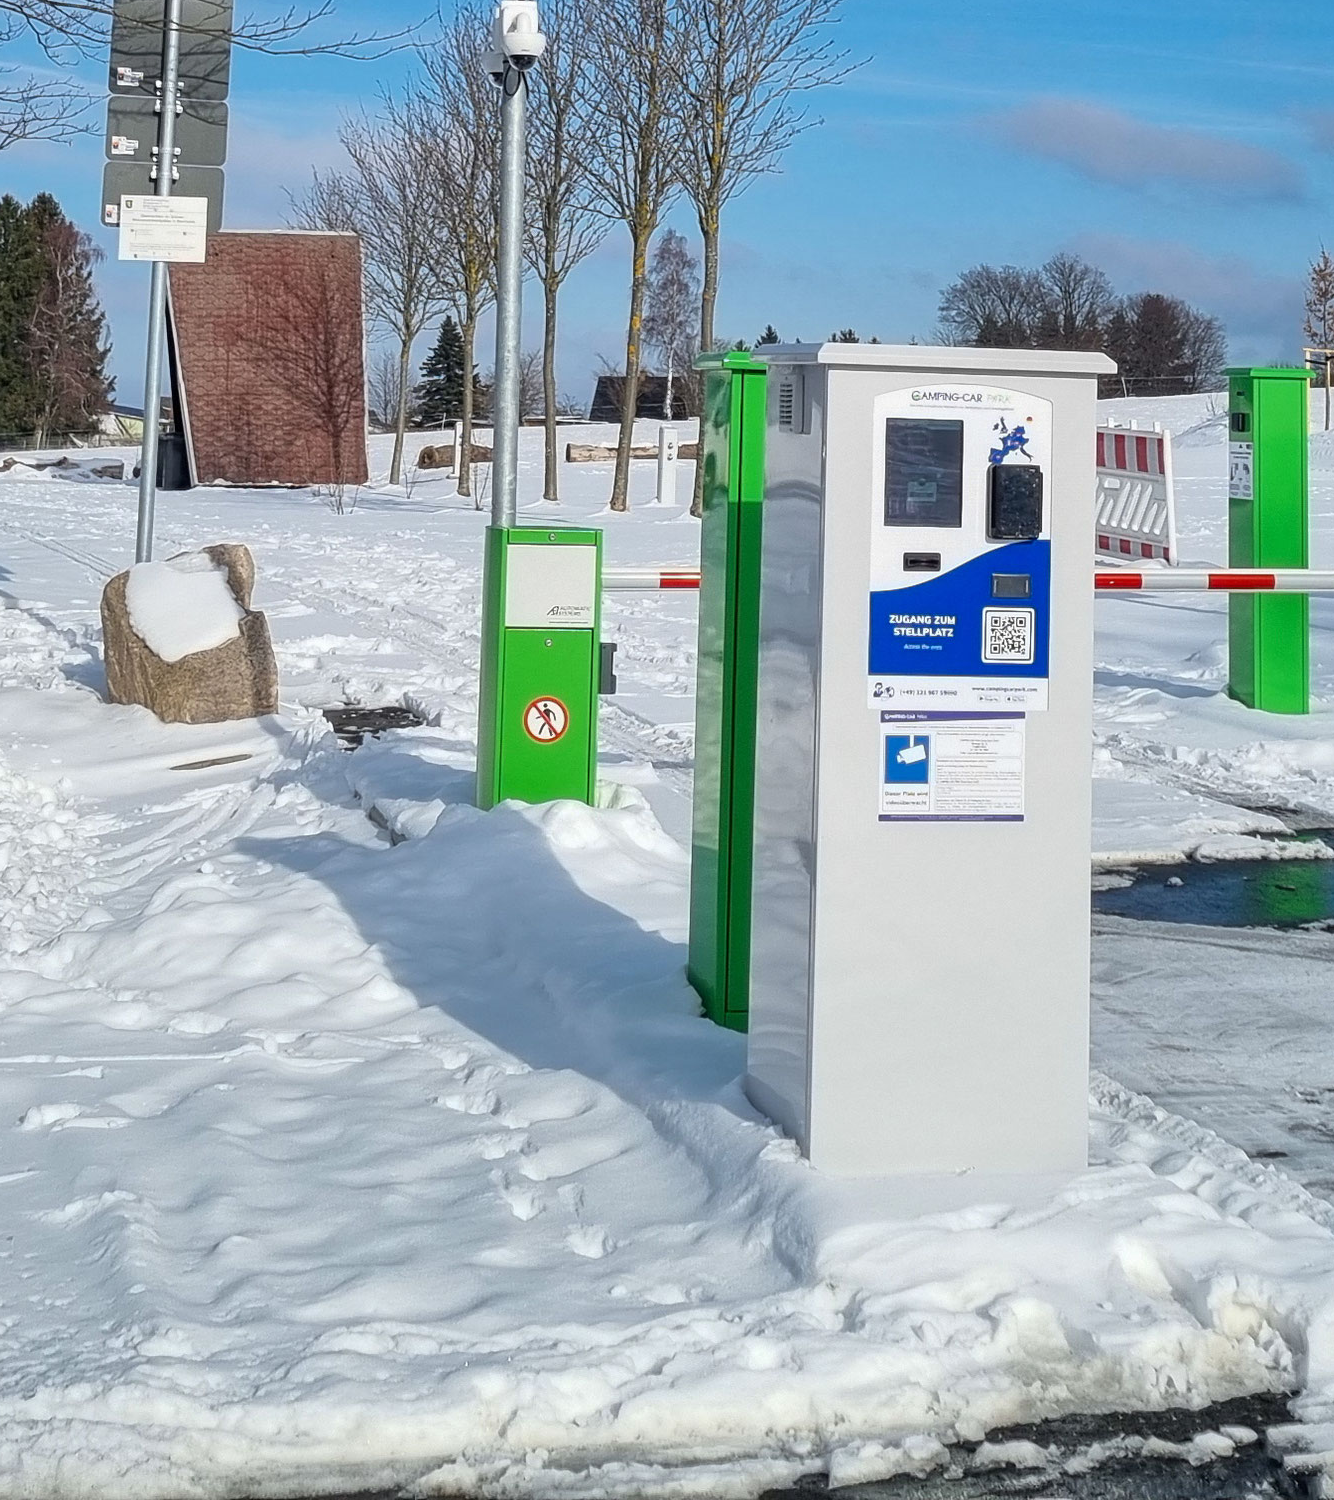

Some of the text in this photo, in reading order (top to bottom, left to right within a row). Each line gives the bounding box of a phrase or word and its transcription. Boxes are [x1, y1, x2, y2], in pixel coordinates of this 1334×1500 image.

[911, 390, 983, 402] CAMPING-CAR
[889, 614, 956, 625] ZUGANG ZUM
[893, 627, 954, 637] STELLPLATZ
